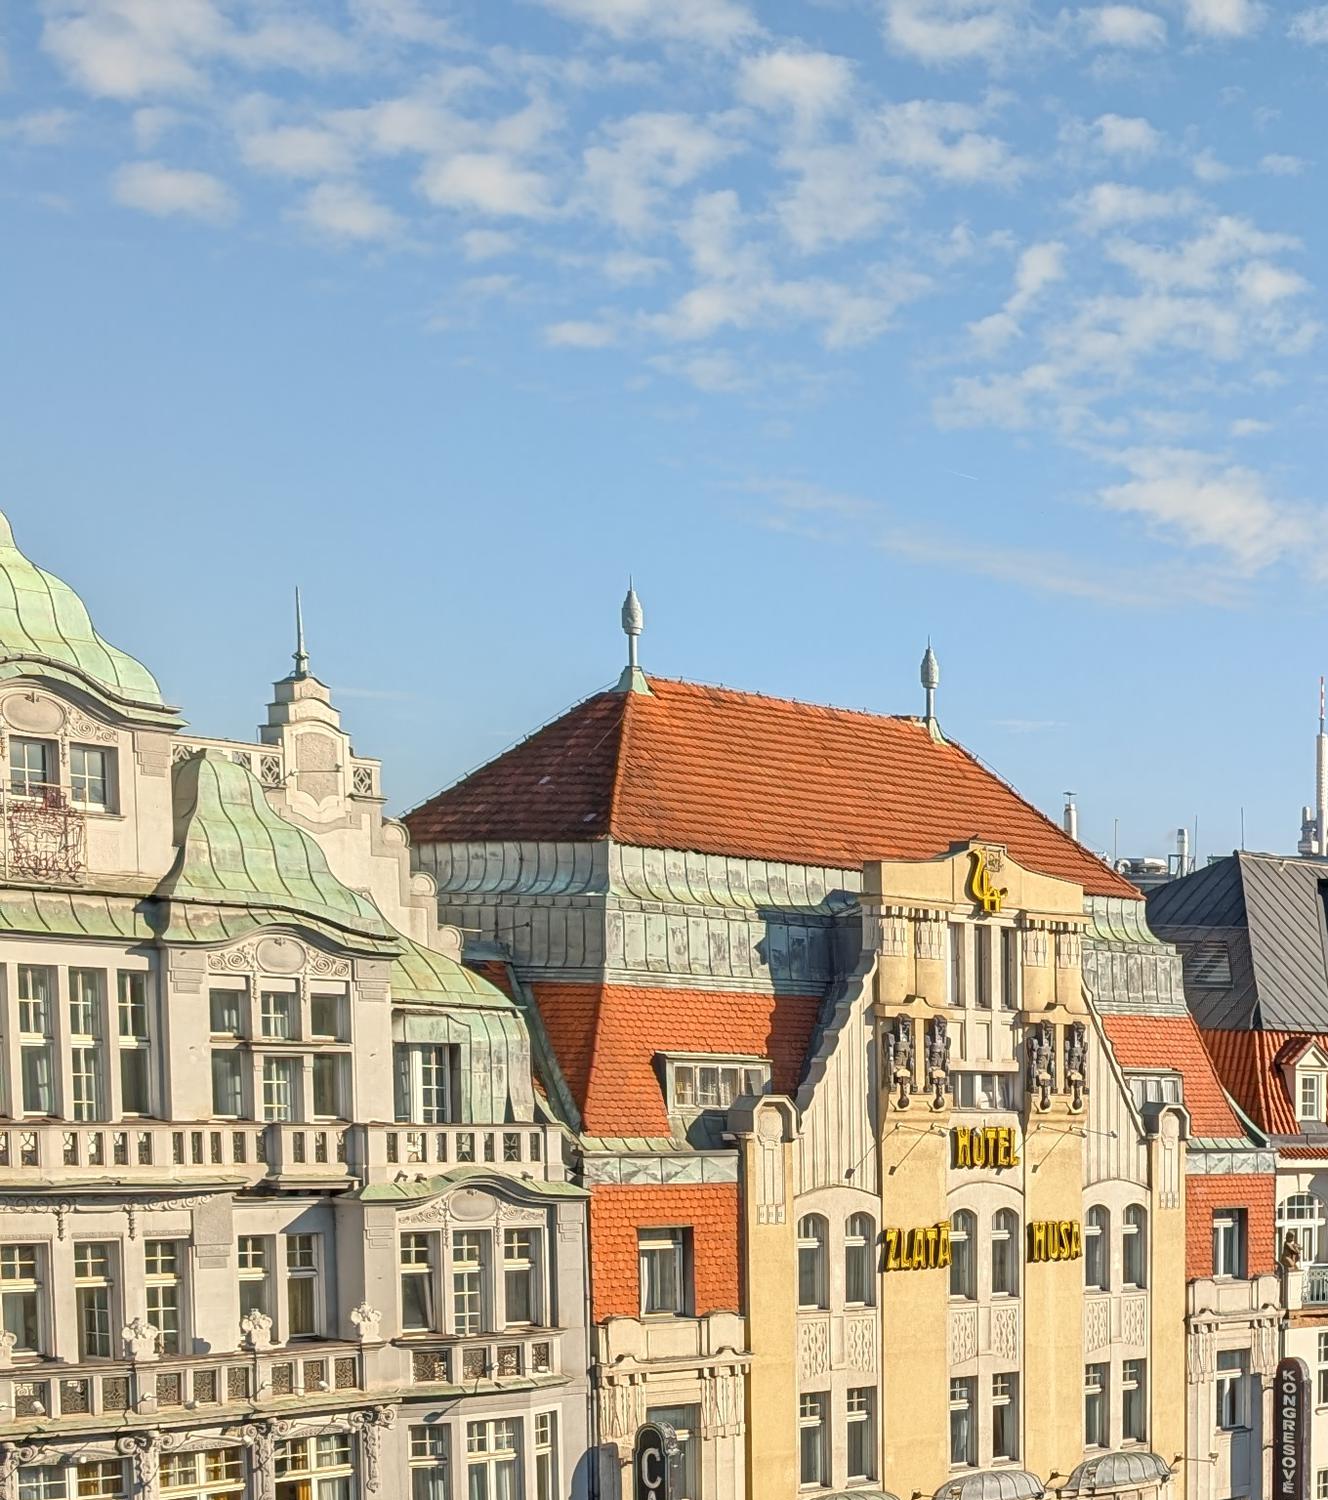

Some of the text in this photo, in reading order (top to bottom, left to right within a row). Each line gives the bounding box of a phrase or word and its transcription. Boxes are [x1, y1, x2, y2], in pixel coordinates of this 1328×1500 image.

[957, 1127, 1020, 1168] HOTEL
[886, 1220, 1083, 1271] ZLATÁ HUSA
